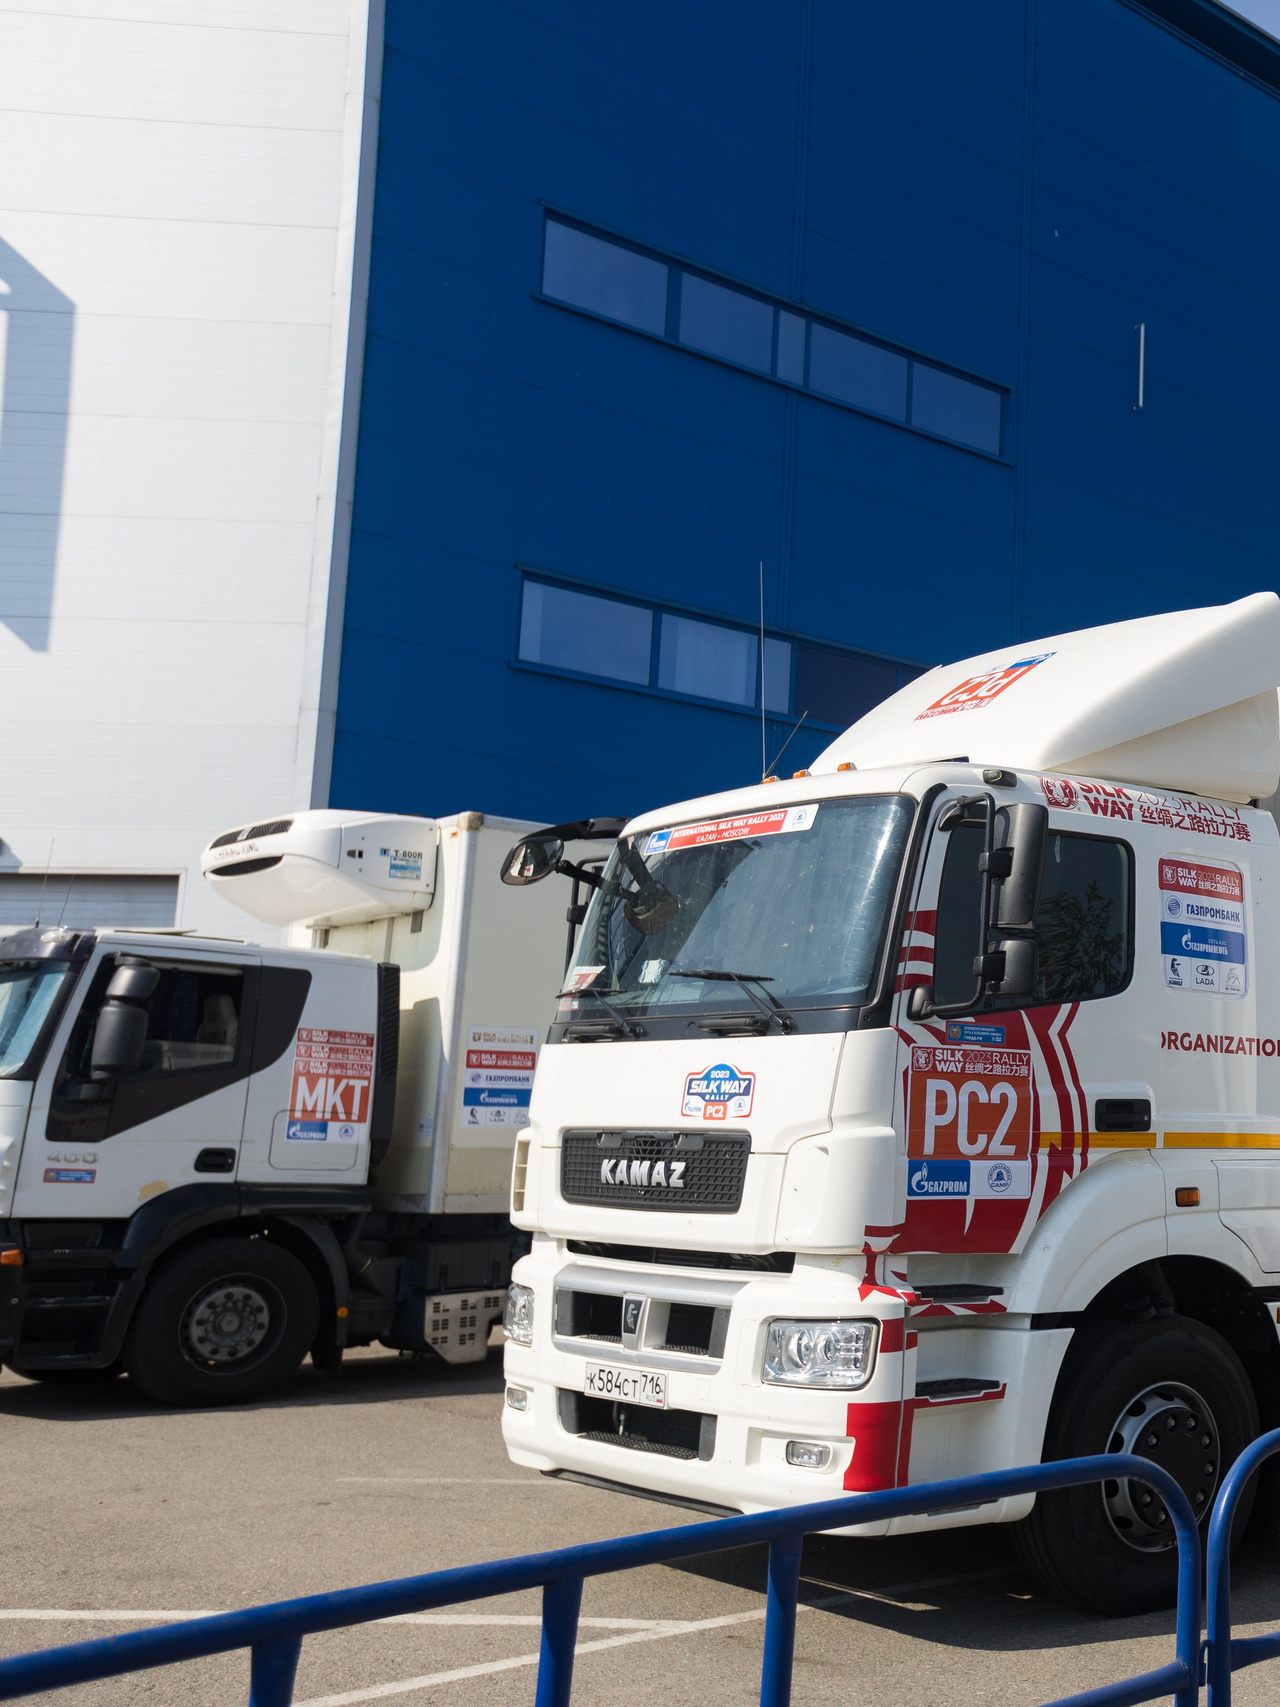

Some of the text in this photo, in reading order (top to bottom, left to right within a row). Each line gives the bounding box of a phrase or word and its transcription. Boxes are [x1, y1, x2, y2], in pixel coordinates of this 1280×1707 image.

[1076, 781, 1133, 801] SILK
[1083, 795, 1134, 820] WAY
[672, 812, 786, 839] INTERNATIONAL SILK WAY RALLY 2023
[696, 832, 717, 843] KAZAN
[721, 827, 751, 839] MOSCOW
[1177, 867, 1197, 879] SILK
[1178, 876, 1198, 888] WAY
[1186, 903, 1241, 922] ГАЗПРОМБАНК
[1195, 977, 1215, 986] LADA
[935, 1049, 964, 1061] SILK
[935, 1061, 964, 1073] WAY
[485, 1075, 531, 1083] ГАЗПРОМБАНК
[710, 1070, 731, 1079] 2023
[689, 1080, 750, 1094] SILK WAY
[294, 1076, 369, 1121] MKT
[706, 1105, 725, 1118] PC2
[923, 1078, 1018, 1156] PC2
[47, 1151, 99, 1164] 400
[601, 1159, 687, 1188] KAMAZ
[928, 1181, 968, 1193] GAZPROM
[642, 1374, 662, 1395] 716
